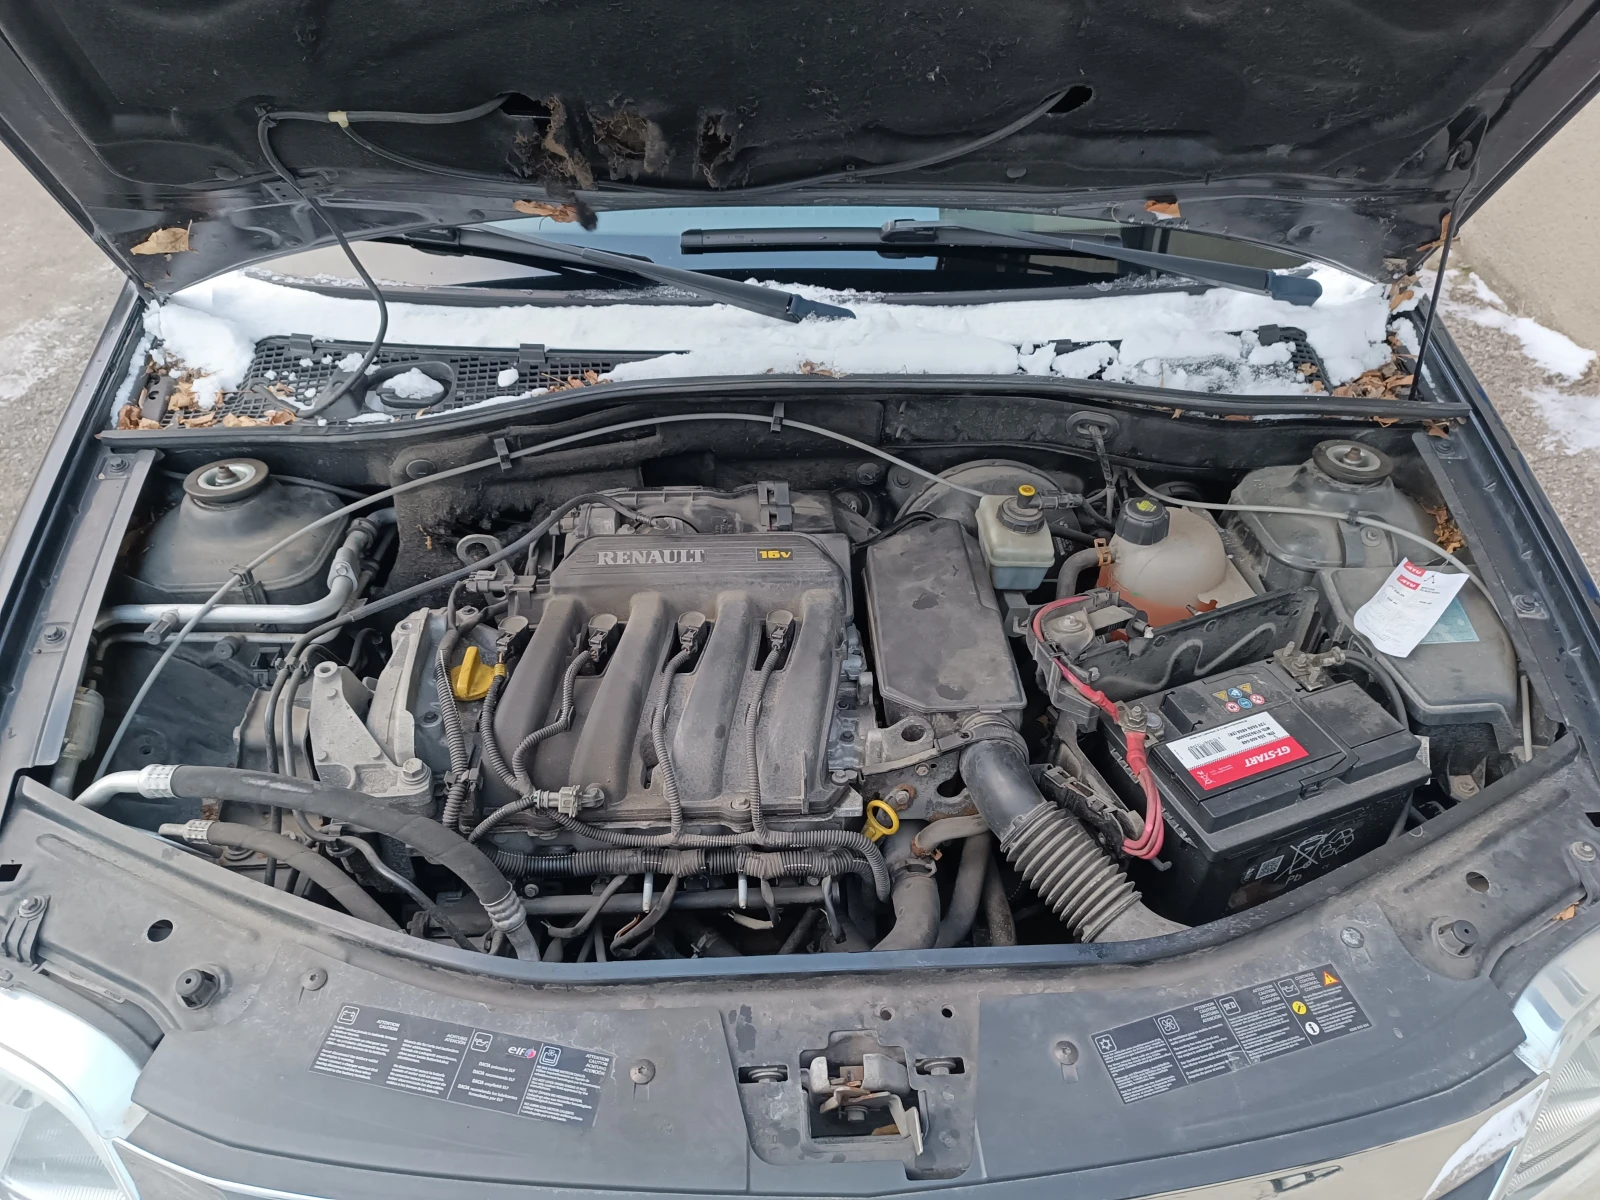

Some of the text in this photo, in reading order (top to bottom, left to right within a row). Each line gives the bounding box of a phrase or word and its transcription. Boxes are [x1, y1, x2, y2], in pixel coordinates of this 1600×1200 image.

[596, 549, 705, 566] RENAULT
[1245, 745, 1291, 768] GT-START
[376, 1020, 400, 1028] ATTENTION
[508, 1046, 527, 1056] elf
[586, 1054, 610, 1062] ATTENTION
